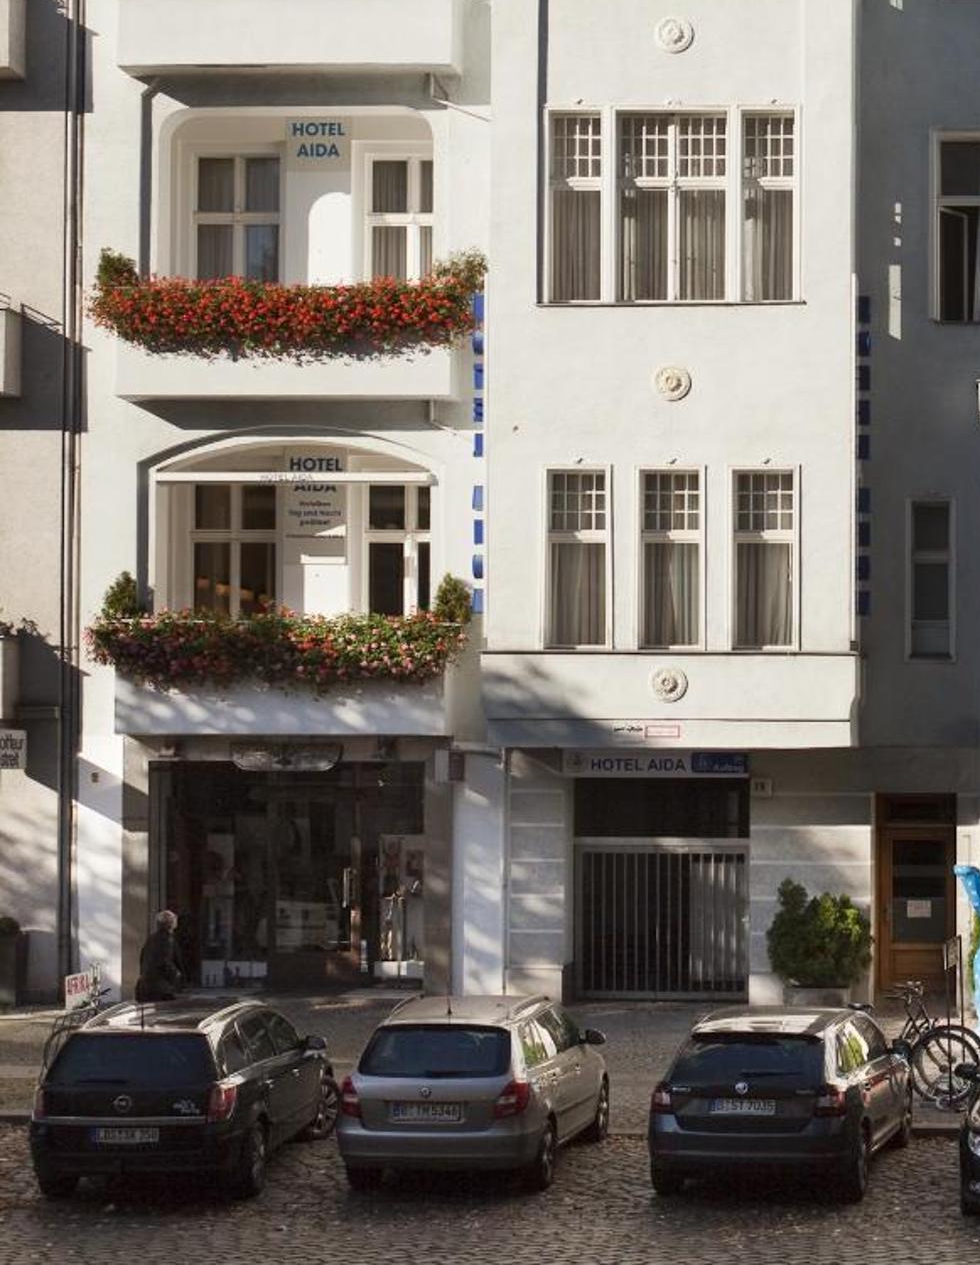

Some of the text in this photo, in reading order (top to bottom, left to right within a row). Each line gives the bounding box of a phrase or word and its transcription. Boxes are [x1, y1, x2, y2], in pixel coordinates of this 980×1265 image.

[292, 122, 345, 136] HOTEL
[296, 143, 340, 157] AIDA
[289, 457, 344, 472] HOTEL
[591, 758, 645, 771] HOTEL
[647, 758, 686, 771] AIDA
